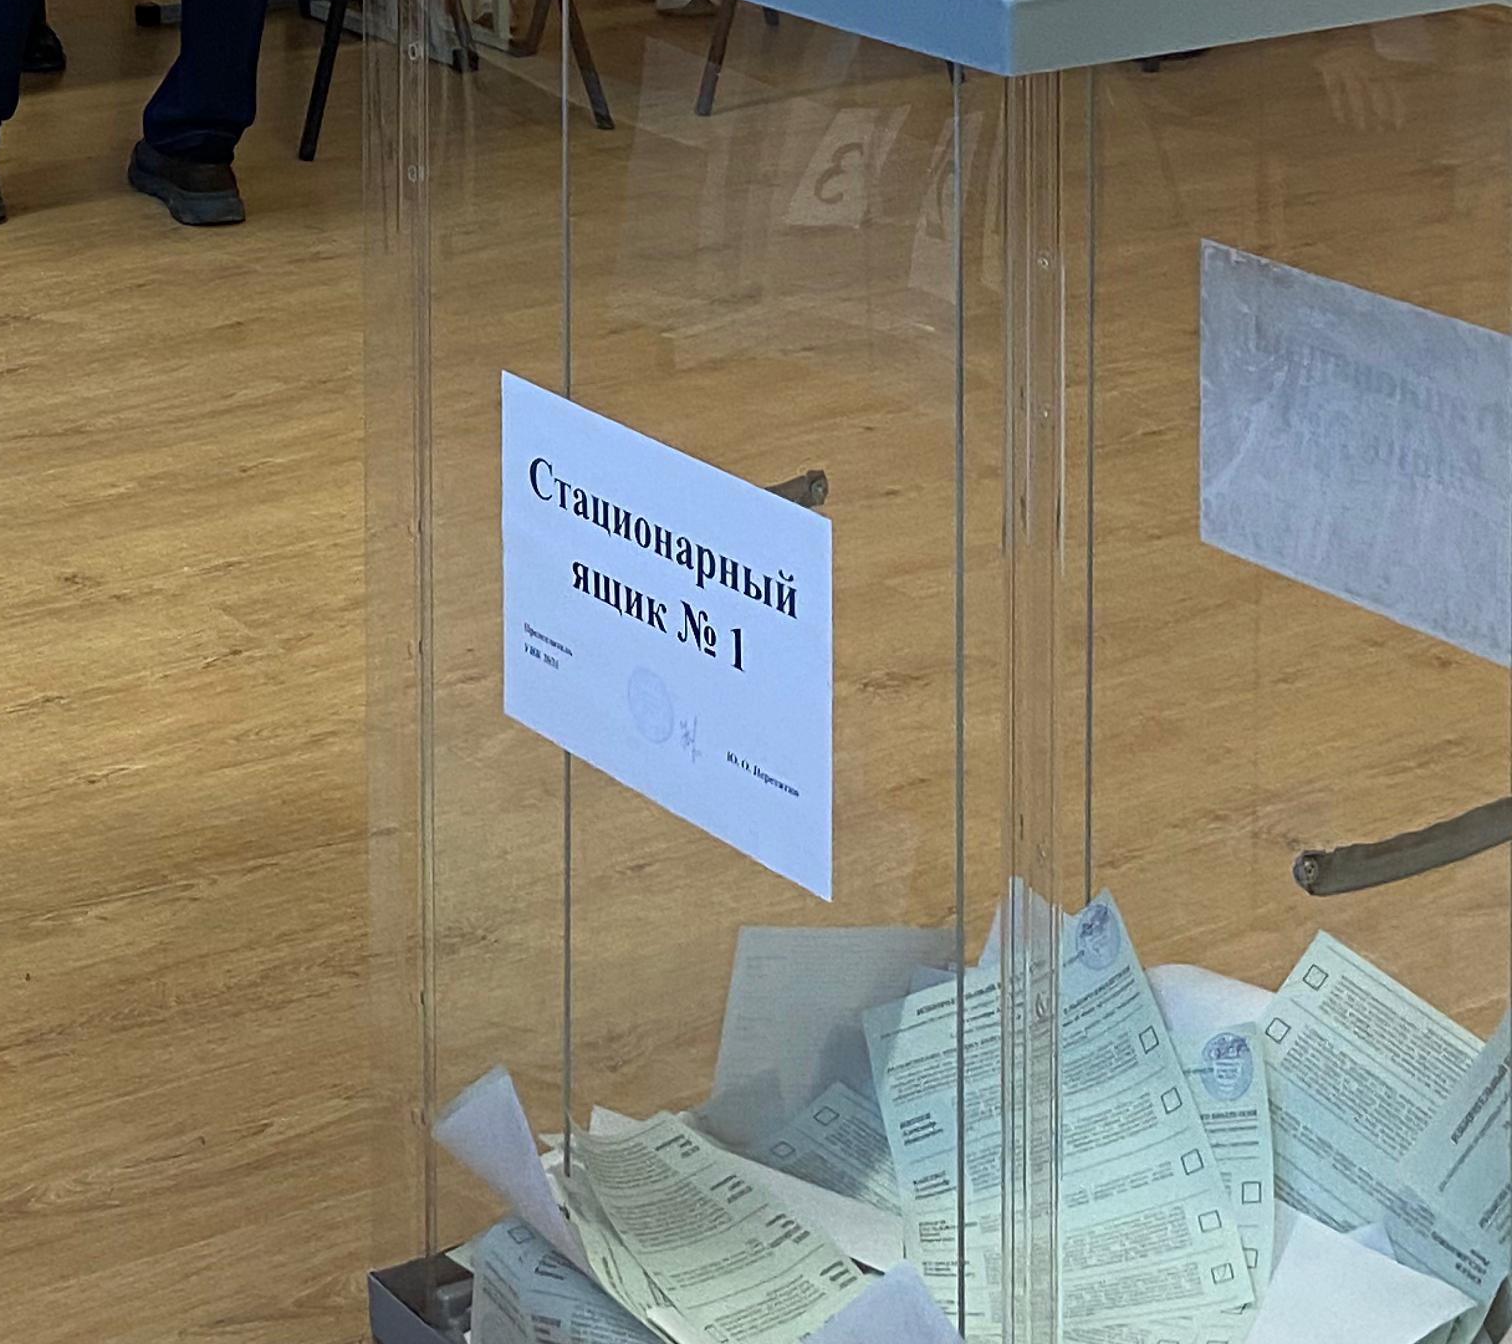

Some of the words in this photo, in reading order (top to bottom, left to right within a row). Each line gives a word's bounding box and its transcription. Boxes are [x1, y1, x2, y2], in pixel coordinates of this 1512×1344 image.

[528, 455, 798, 620] Стационарный
[571, 560, 668, 634] ящик
[676, 599, 718, 658] №
[730, 626, 745, 672] 1
